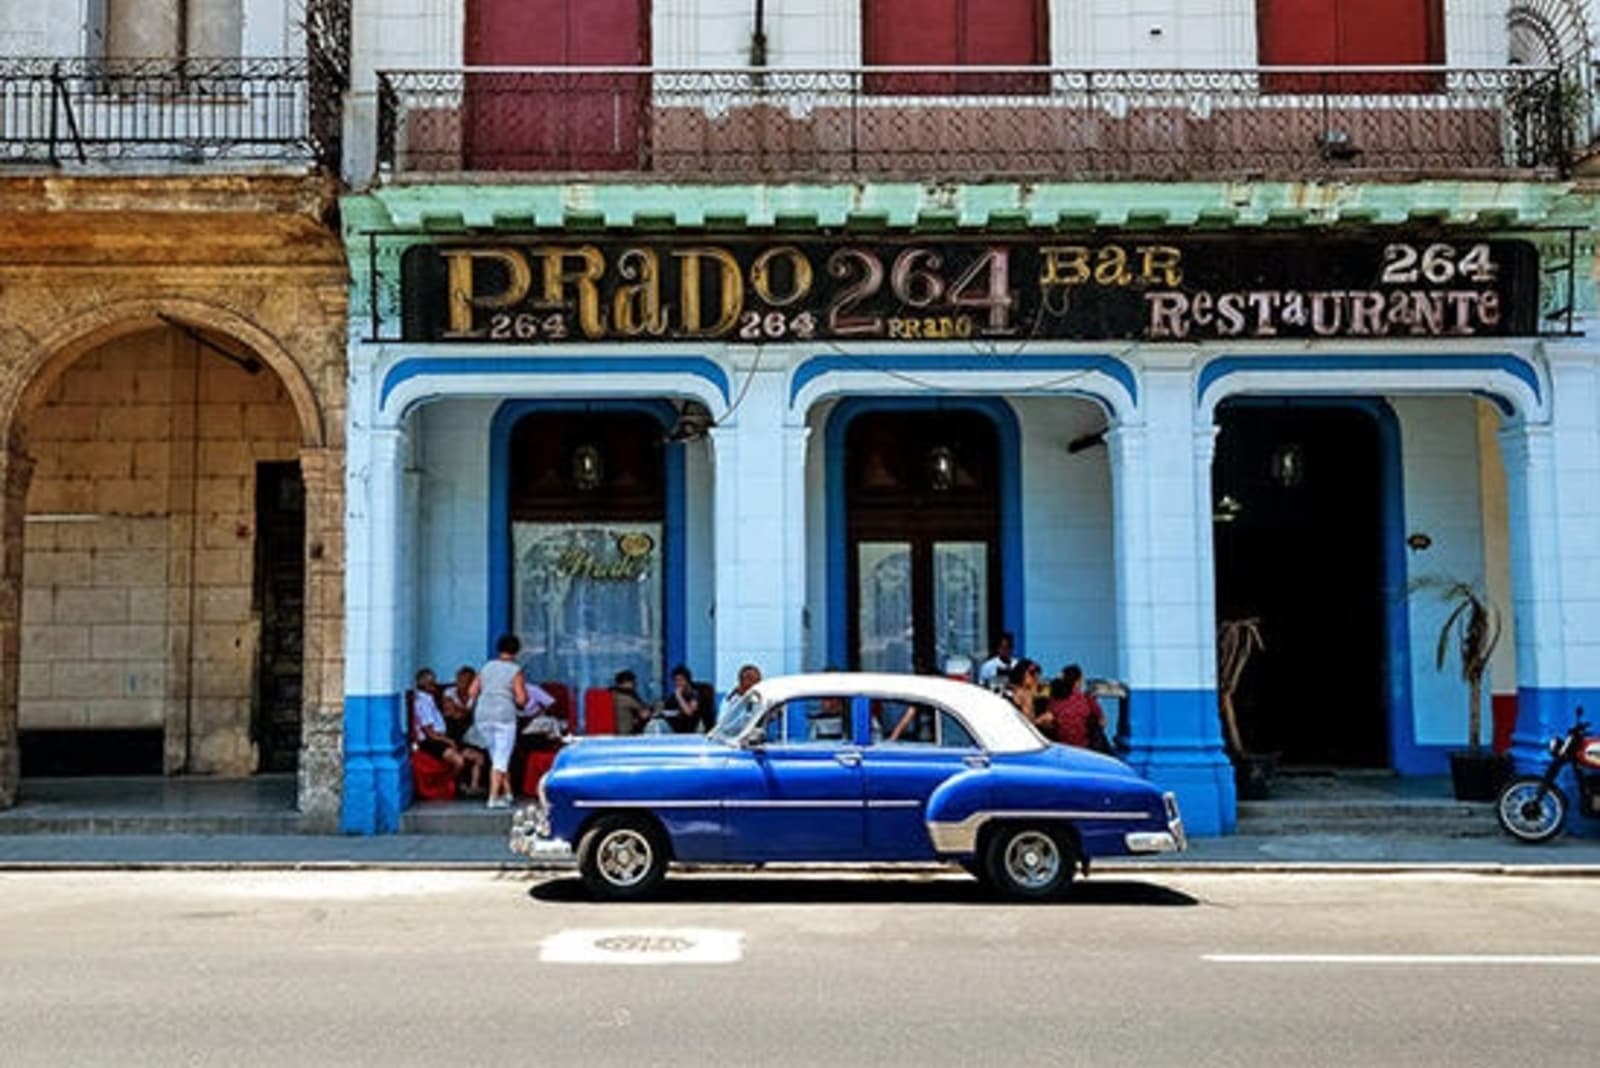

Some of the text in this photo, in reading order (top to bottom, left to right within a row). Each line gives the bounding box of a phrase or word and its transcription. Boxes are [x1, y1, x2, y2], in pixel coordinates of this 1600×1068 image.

[1380, 243, 1496, 284] 264
[828, 246, 1015, 336] 264
[490, 312, 567, 338] 264
[739, 311, 816, 338] 264
